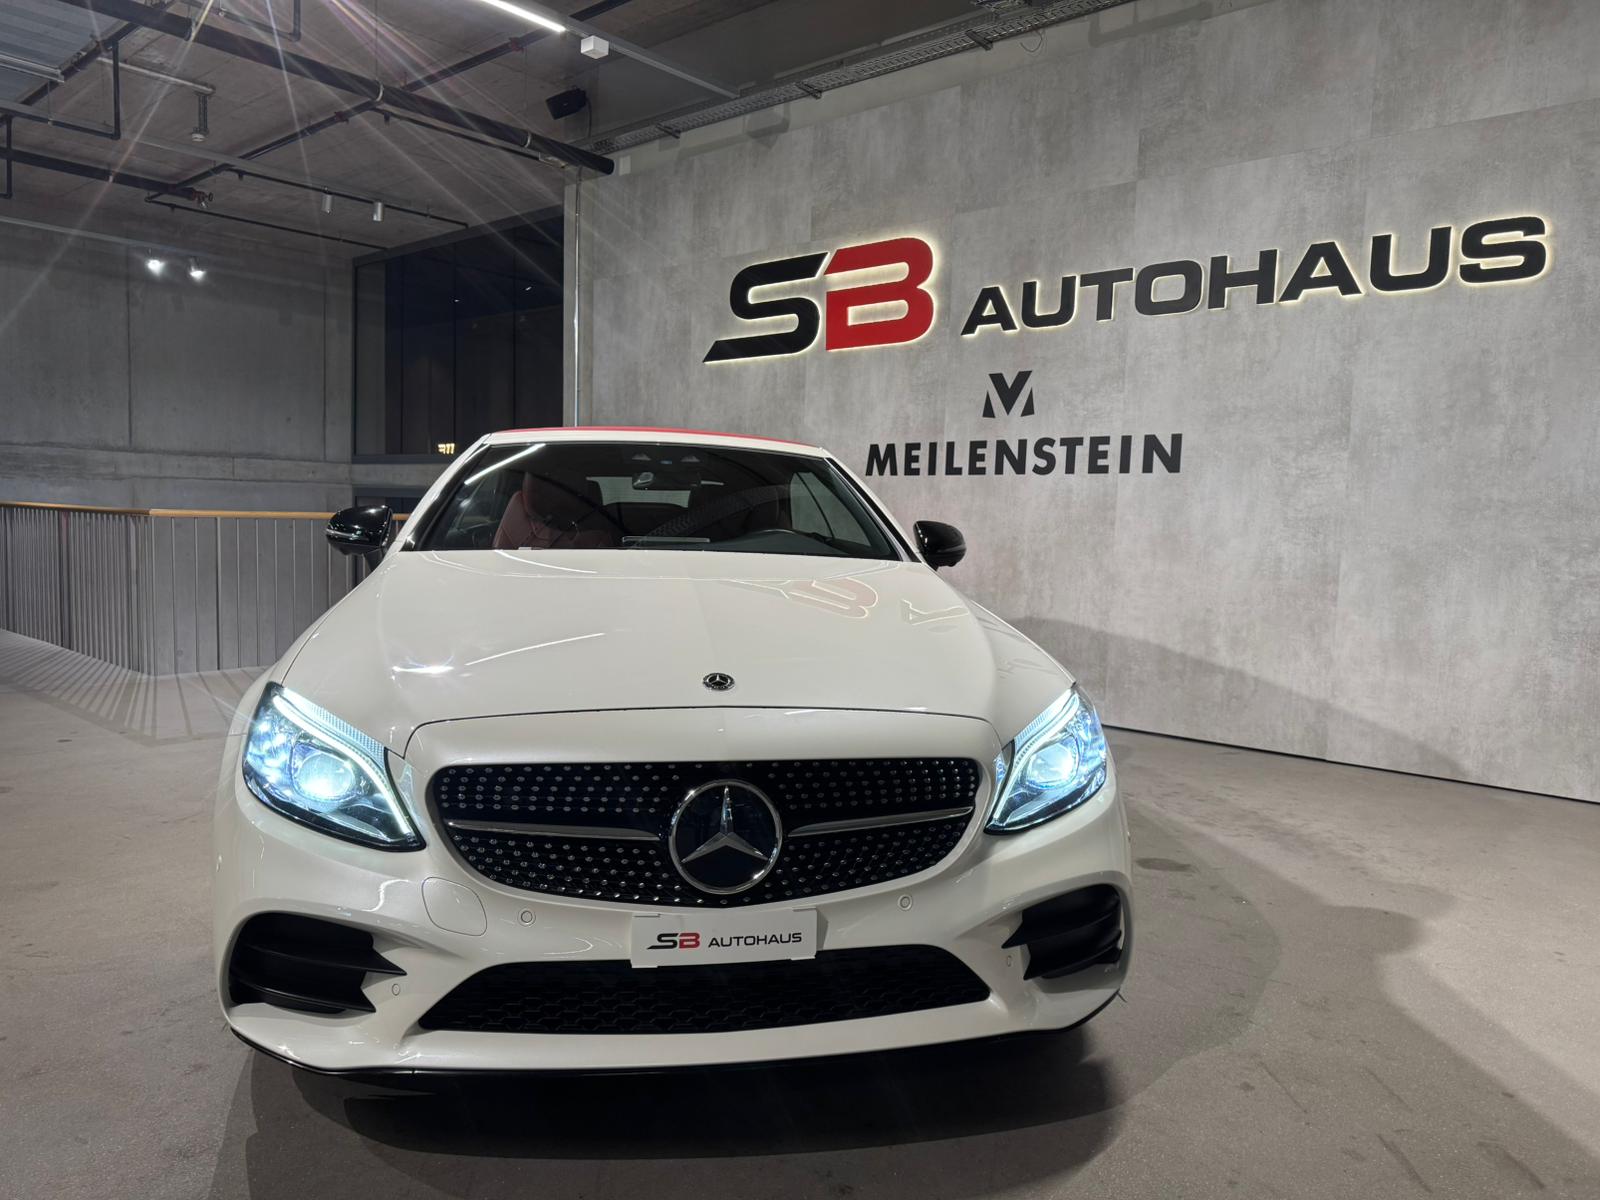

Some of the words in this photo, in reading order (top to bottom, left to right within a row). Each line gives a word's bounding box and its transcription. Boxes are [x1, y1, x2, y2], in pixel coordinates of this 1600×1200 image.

[703, 236, 935, 362] SB
[961, 216, 1548, 337] AUTOHAUS
[866, 433, 1182, 476] MEILENSTEIN
[647, 932, 701, 950] SB
[708, 932, 802, 948] AUTOHAUS
